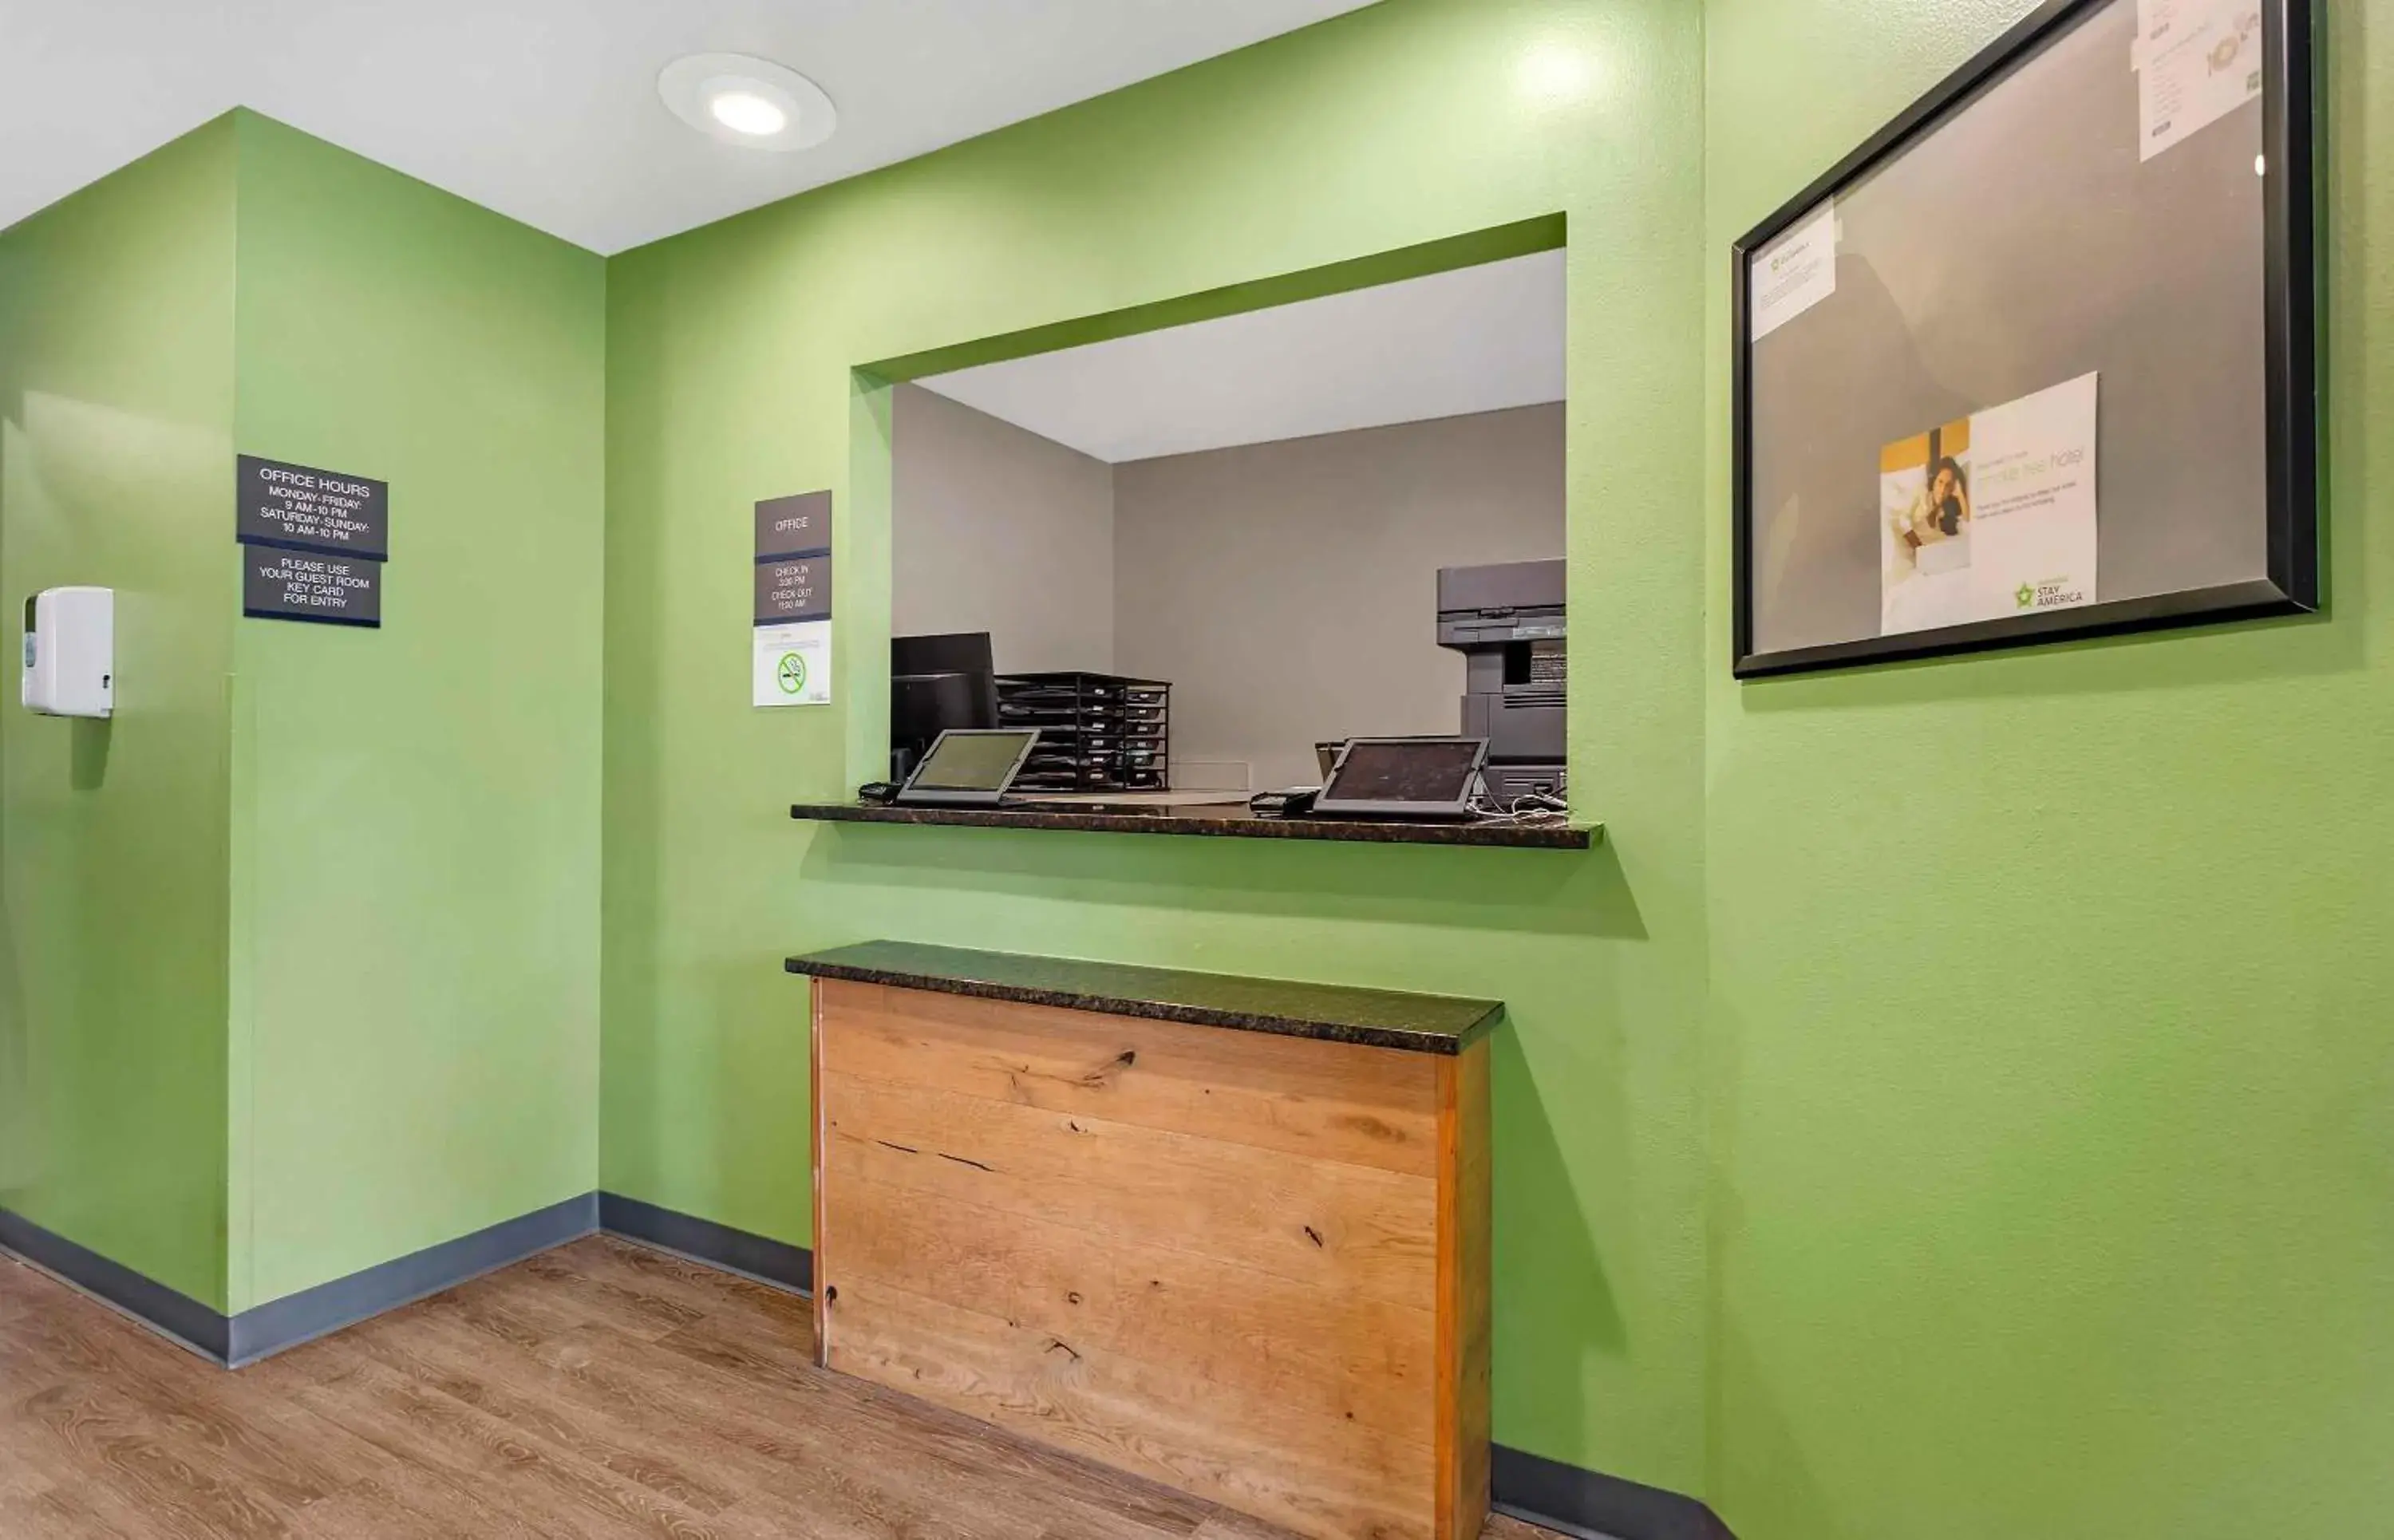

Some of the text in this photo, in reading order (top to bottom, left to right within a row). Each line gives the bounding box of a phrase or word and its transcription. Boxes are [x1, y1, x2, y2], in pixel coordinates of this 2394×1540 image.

[259, 468, 370, 498] OFFICE HOURS
[285, 500, 293, 510] 9
[331, 507, 348, 519] PM
[283, 523, 294, 532] 10
[333, 529, 350, 540] PM
[775, 516, 808, 531] OFFICE
[281, 558, 350, 575] PLEASE USE
[259, 567, 370, 589] YOUR GUEST ROOM
[287, 582, 344, 597] KEY CARD
[2036, 586, 2060, 598] STAY
[283, 593, 347, 609] FOR ENTRY
[2036, 591, 2083, 606] AMERICA
